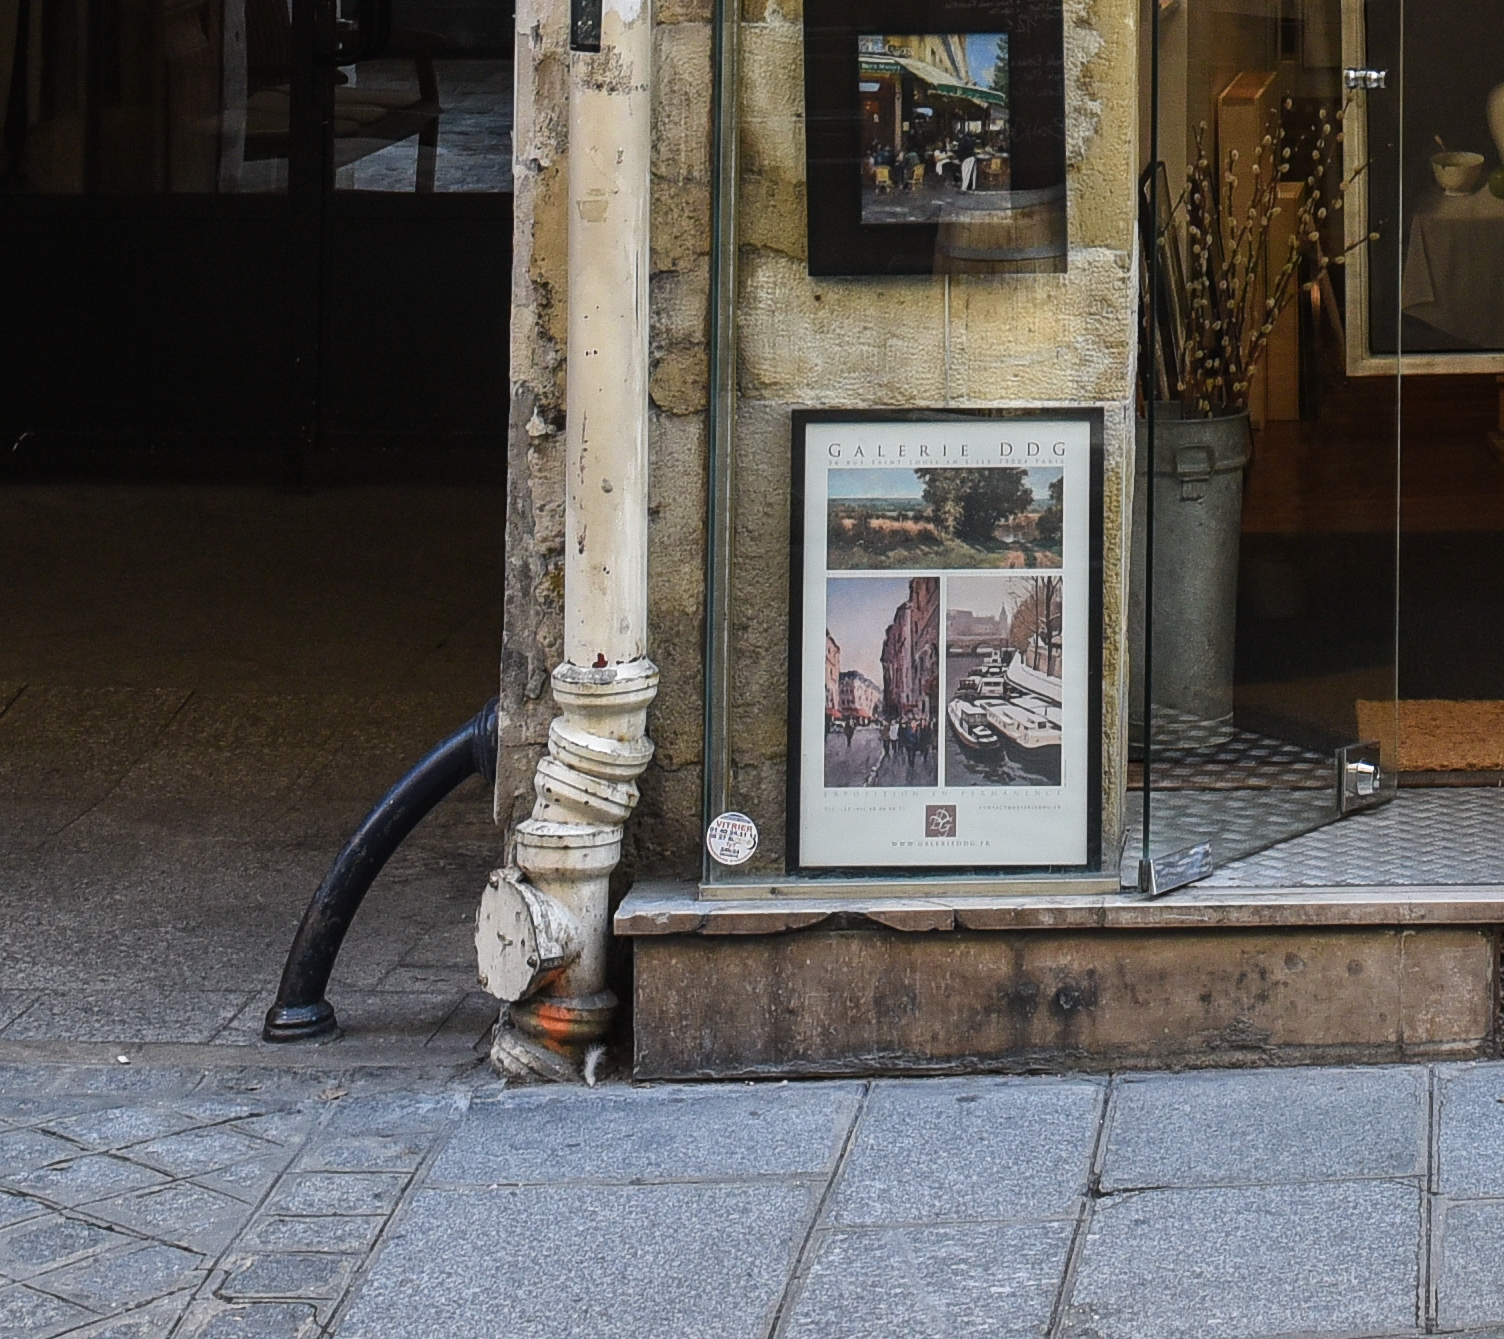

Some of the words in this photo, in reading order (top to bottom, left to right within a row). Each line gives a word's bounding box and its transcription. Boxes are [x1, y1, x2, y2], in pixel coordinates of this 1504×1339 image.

[828, 442, 970, 458] GALERIE
[999, 441, 1066, 457] DDG
[960, 789, 1063, 797] PERMANENCE
[716, 819, 754, 833] VITRIER
